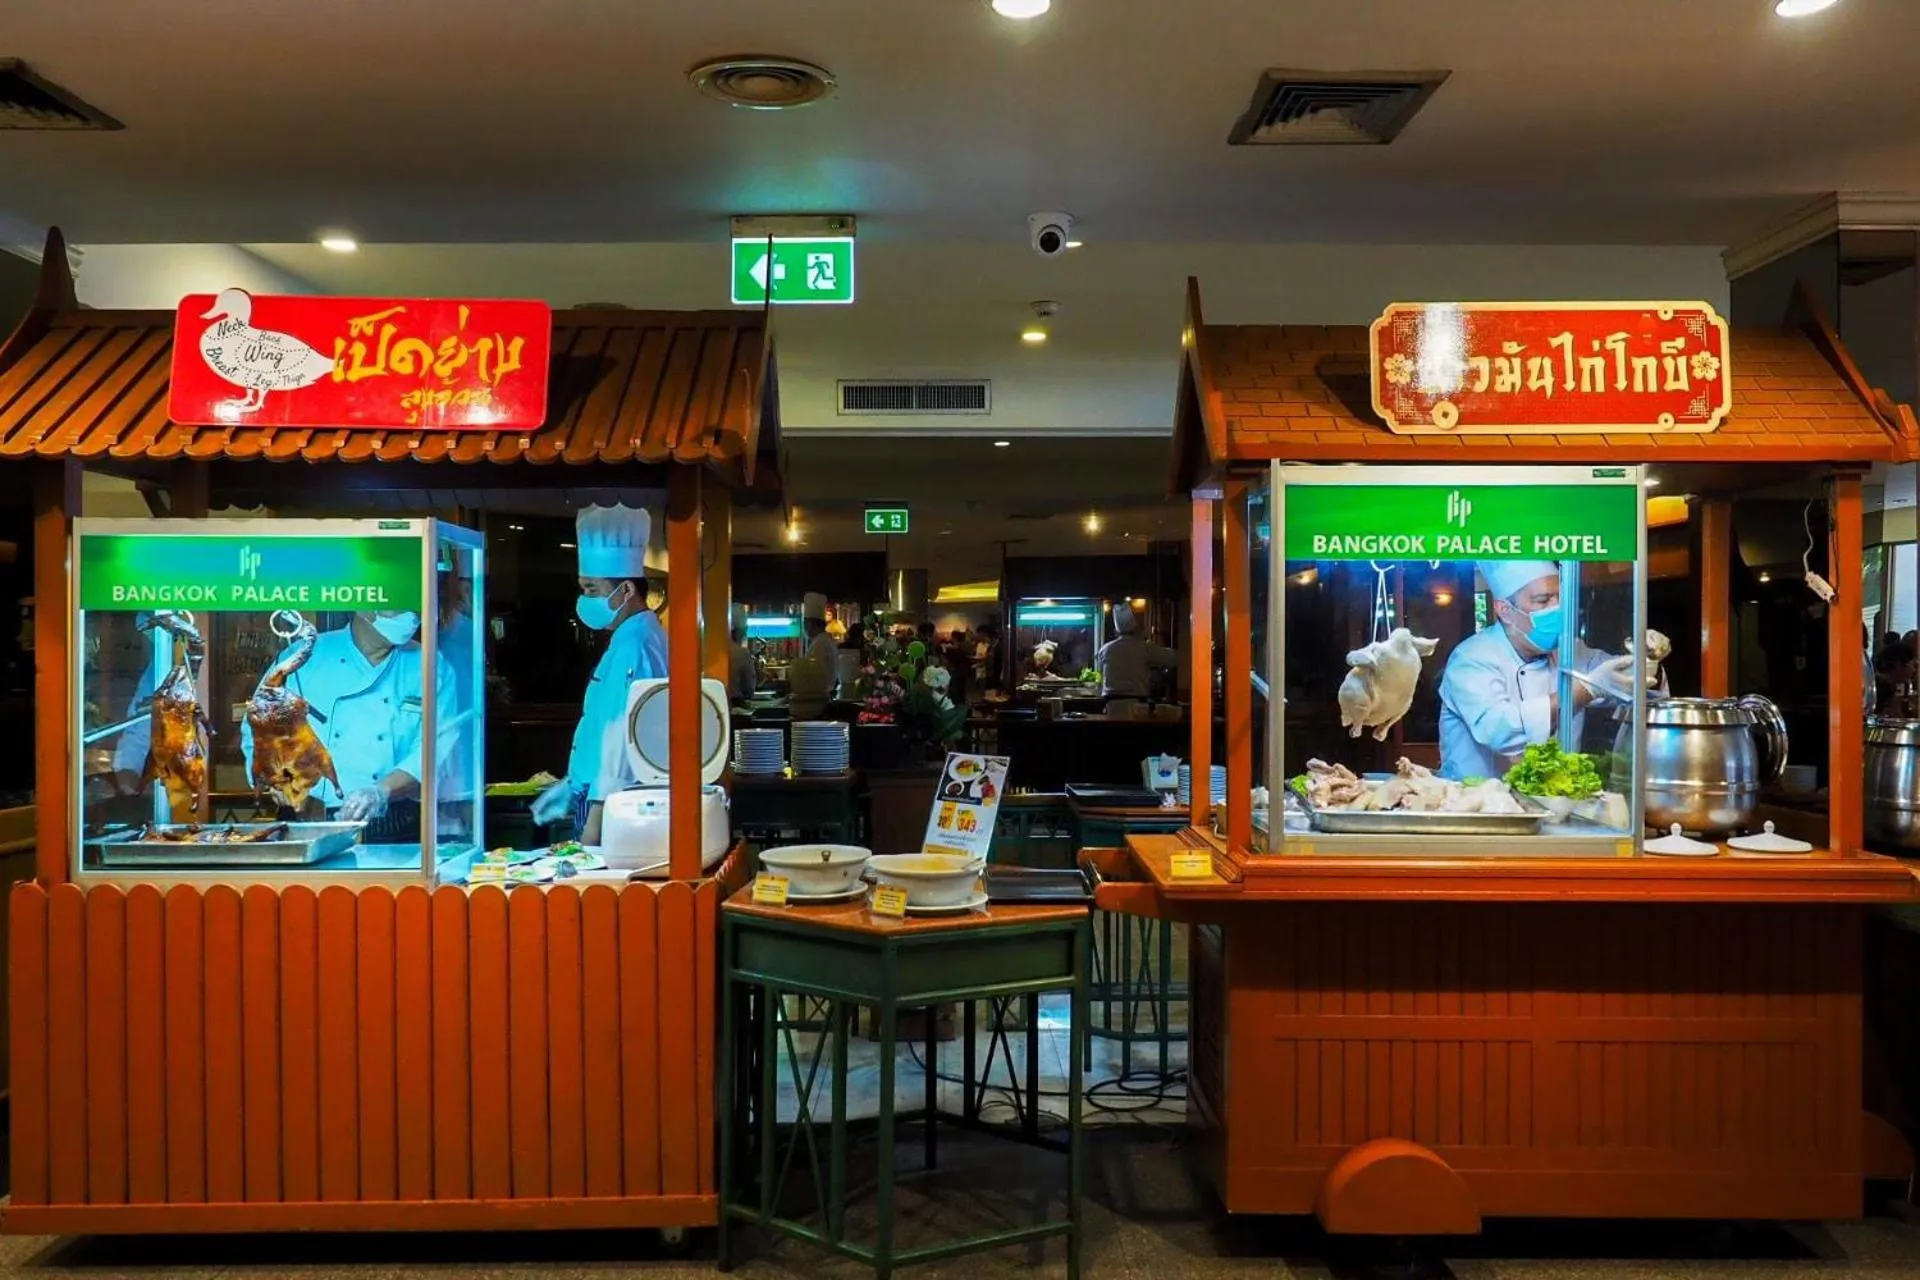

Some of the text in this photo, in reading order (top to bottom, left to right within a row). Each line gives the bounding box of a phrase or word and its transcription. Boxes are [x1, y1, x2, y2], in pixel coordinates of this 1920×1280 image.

[217, 318, 248, 337] Neck
[206, 347, 240, 377] Breast
[244, 344, 284, 369] Wing
[252, 374, 274, 390] Leg
[1312, 534, 1608, 554] BANGKOK PALACE HOTEL
[112, 585, 389, 603] BANGKOK PALACE HOTEL
